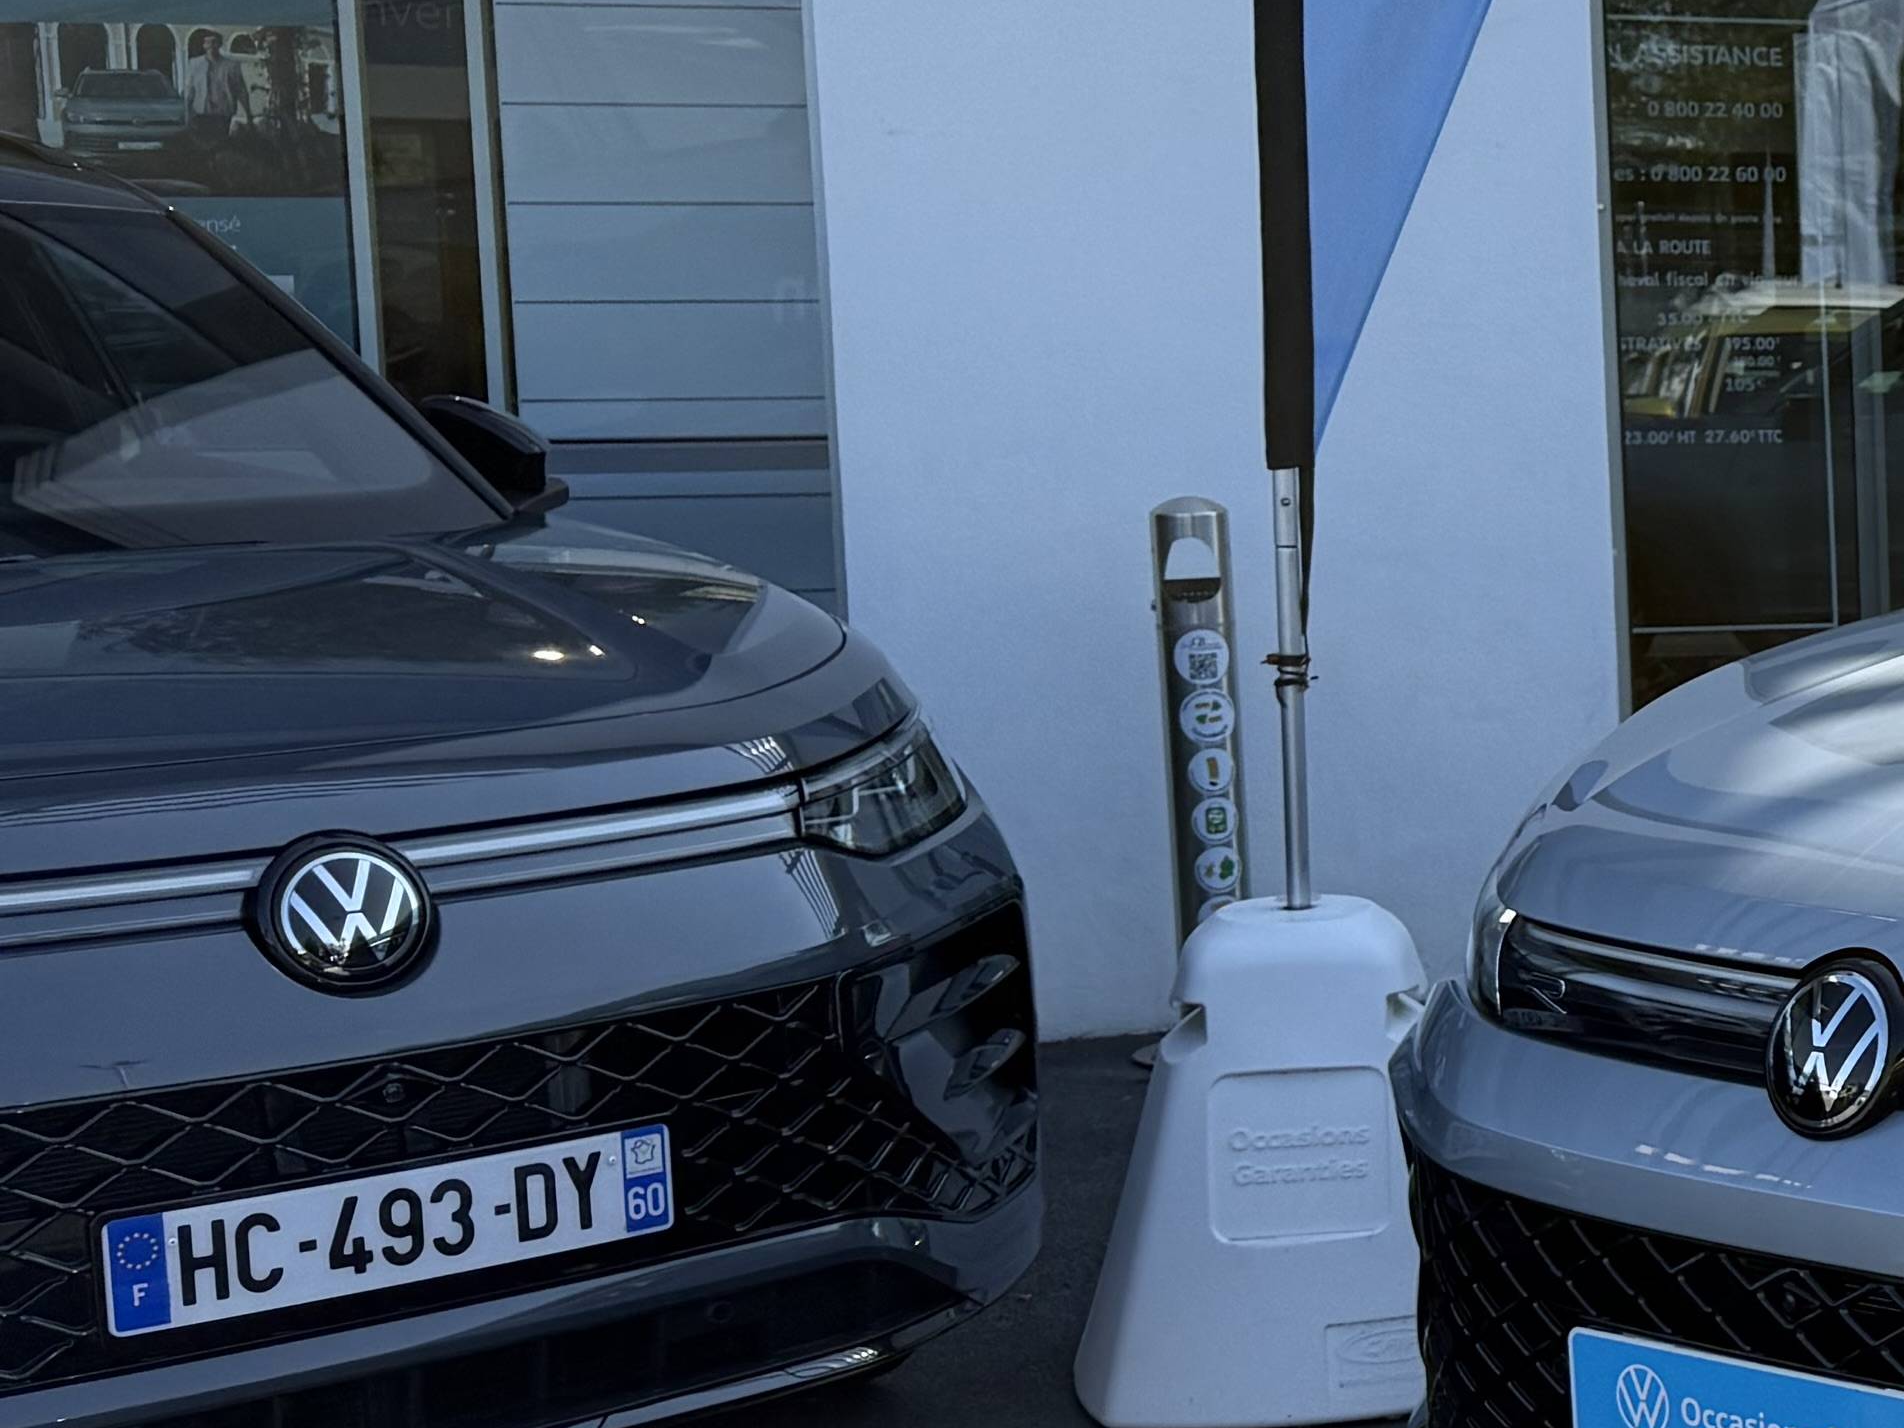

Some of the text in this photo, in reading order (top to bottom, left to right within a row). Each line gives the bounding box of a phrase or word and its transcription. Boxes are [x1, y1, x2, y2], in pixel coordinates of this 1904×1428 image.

[1635, 43, 1784, 68] ASSISTANCE
[1648, 101, 1784, 119] 0 800 22 40 00
[1668, 166, 1703, 183] 800
[1708, 166, 1731, 183] 22
[1736, 166, 1759, 183] 60
[1659, 239, 1712, 255] ROUTE
[1666, 271, 1709, 288] fiscal
[1677, 430, 1697, 444] HT
[1757, 429, 1783, 445] TTC
[1229, 1124, 1370, 1152] Occasions
[1233, 1158, 1369, 1187] Garanties
[627, 1181, 666, 1221] 60
[131, 1282, 149, 1308] F
